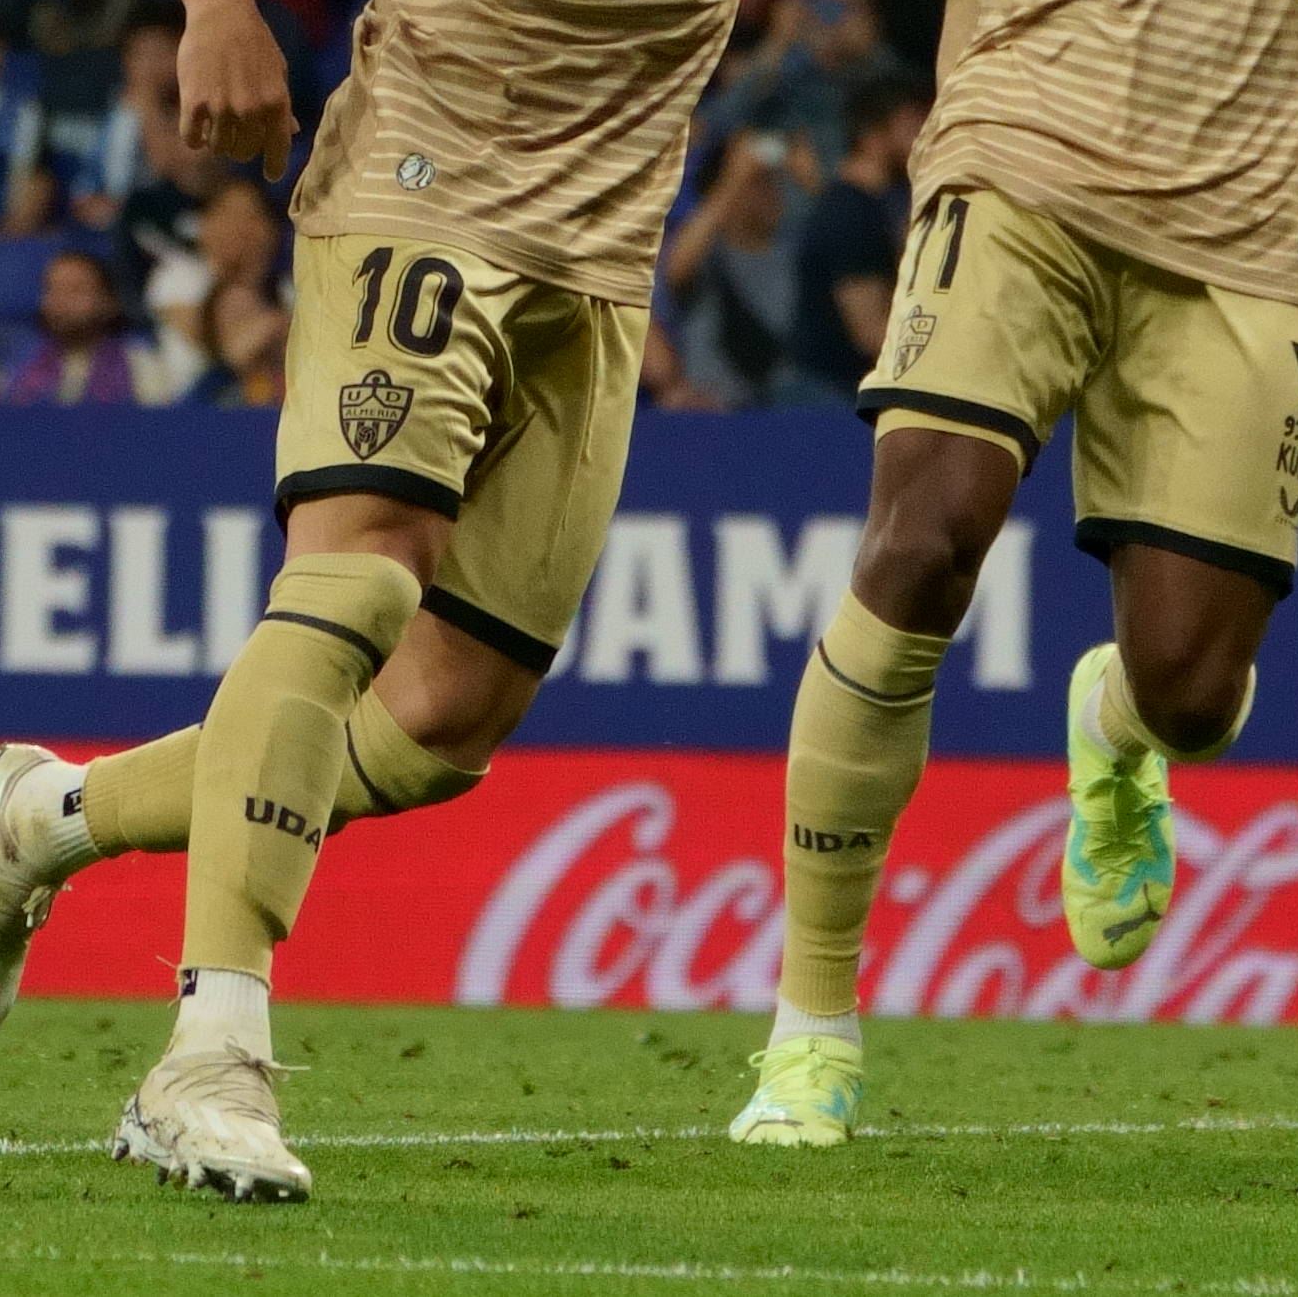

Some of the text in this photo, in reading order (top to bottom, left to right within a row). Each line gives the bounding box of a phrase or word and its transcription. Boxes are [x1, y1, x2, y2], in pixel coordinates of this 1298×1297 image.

[906, 197, 971, 298] 11
[351, 246, 465, 359] 10
[344, 408, 399, 420] ALMERIA
[347, 390, 402, 402] U D
[548, 513, 1035, 691] AM
[244, 796, 323, 854] UDA
[794, 822, 872, 854] UDA
